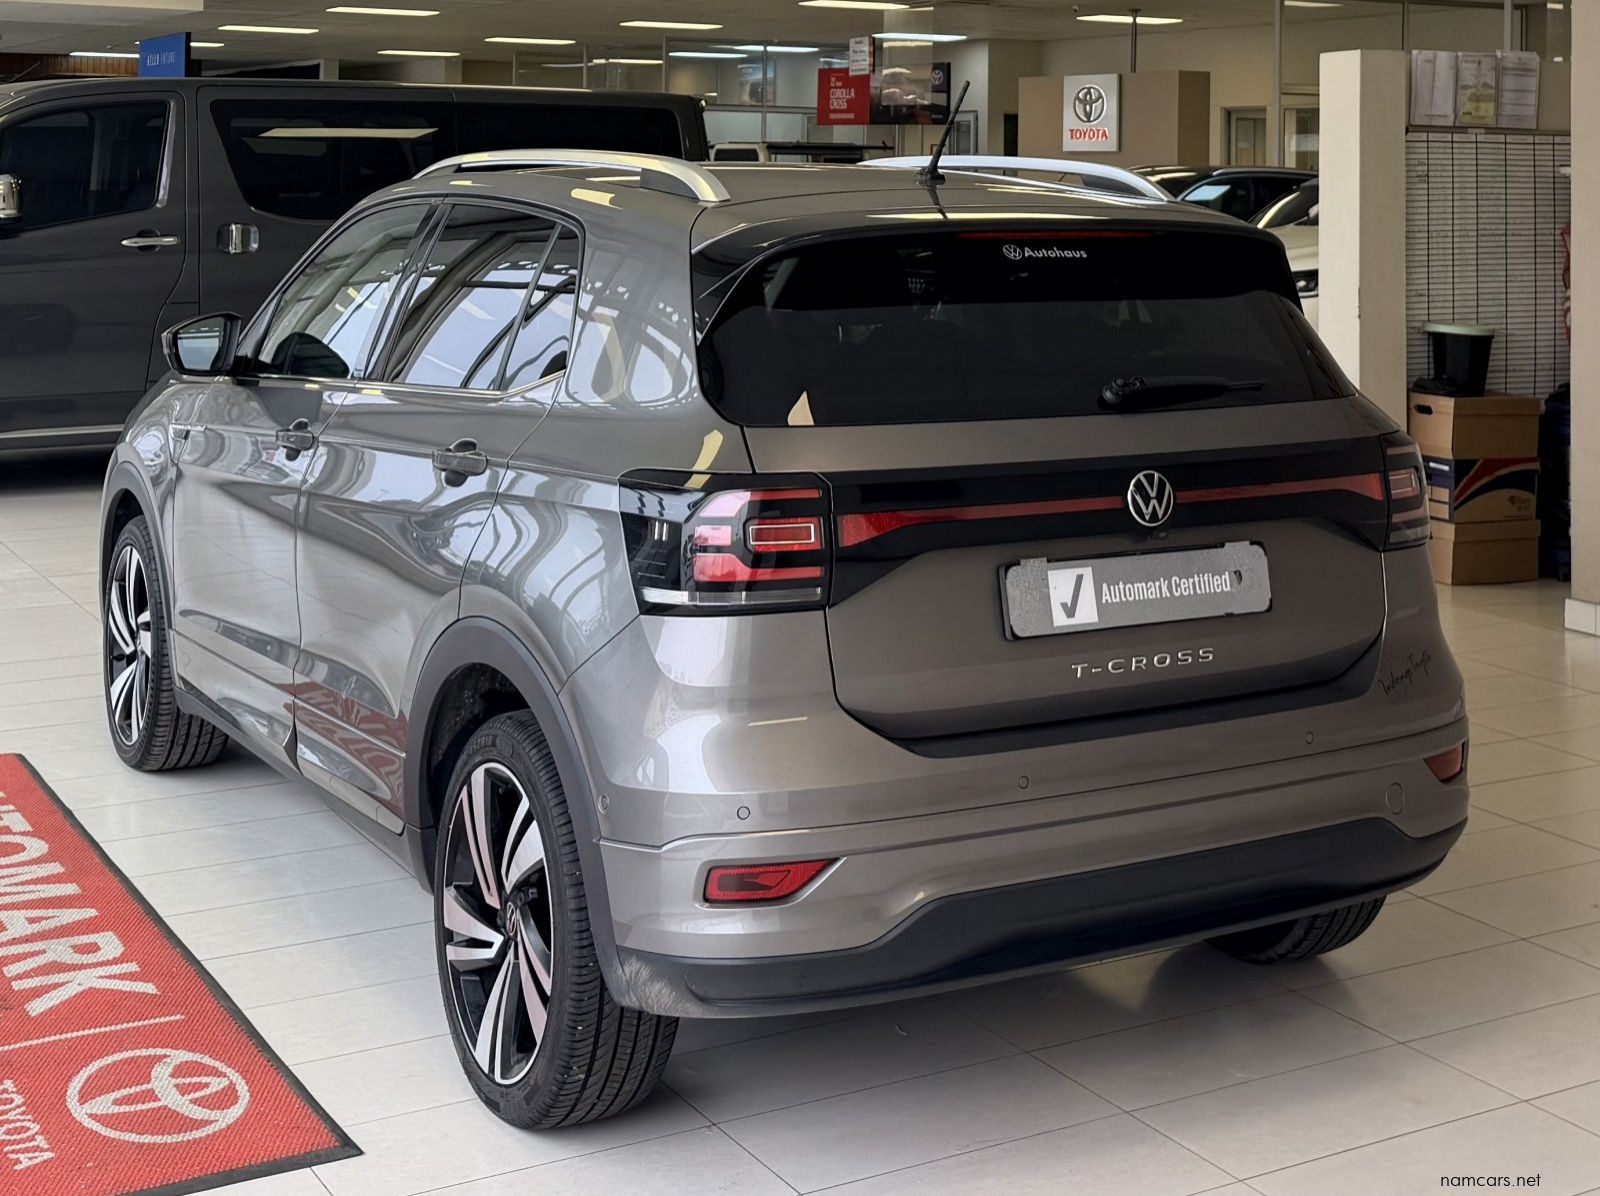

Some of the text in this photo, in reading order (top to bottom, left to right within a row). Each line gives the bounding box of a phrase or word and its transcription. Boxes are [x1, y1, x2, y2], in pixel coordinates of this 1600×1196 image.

[829, 88, 856, 99] COROLLA
[829, 98, 848, 110] CROSS
[1068, 127, 1109, 141] TOYOTA
[1024, 246, 1088, 258] Autohaus
[1102, 571, 1231, 604] Automark Certified
[1071, 647, 1214, 679] T-CROSS
